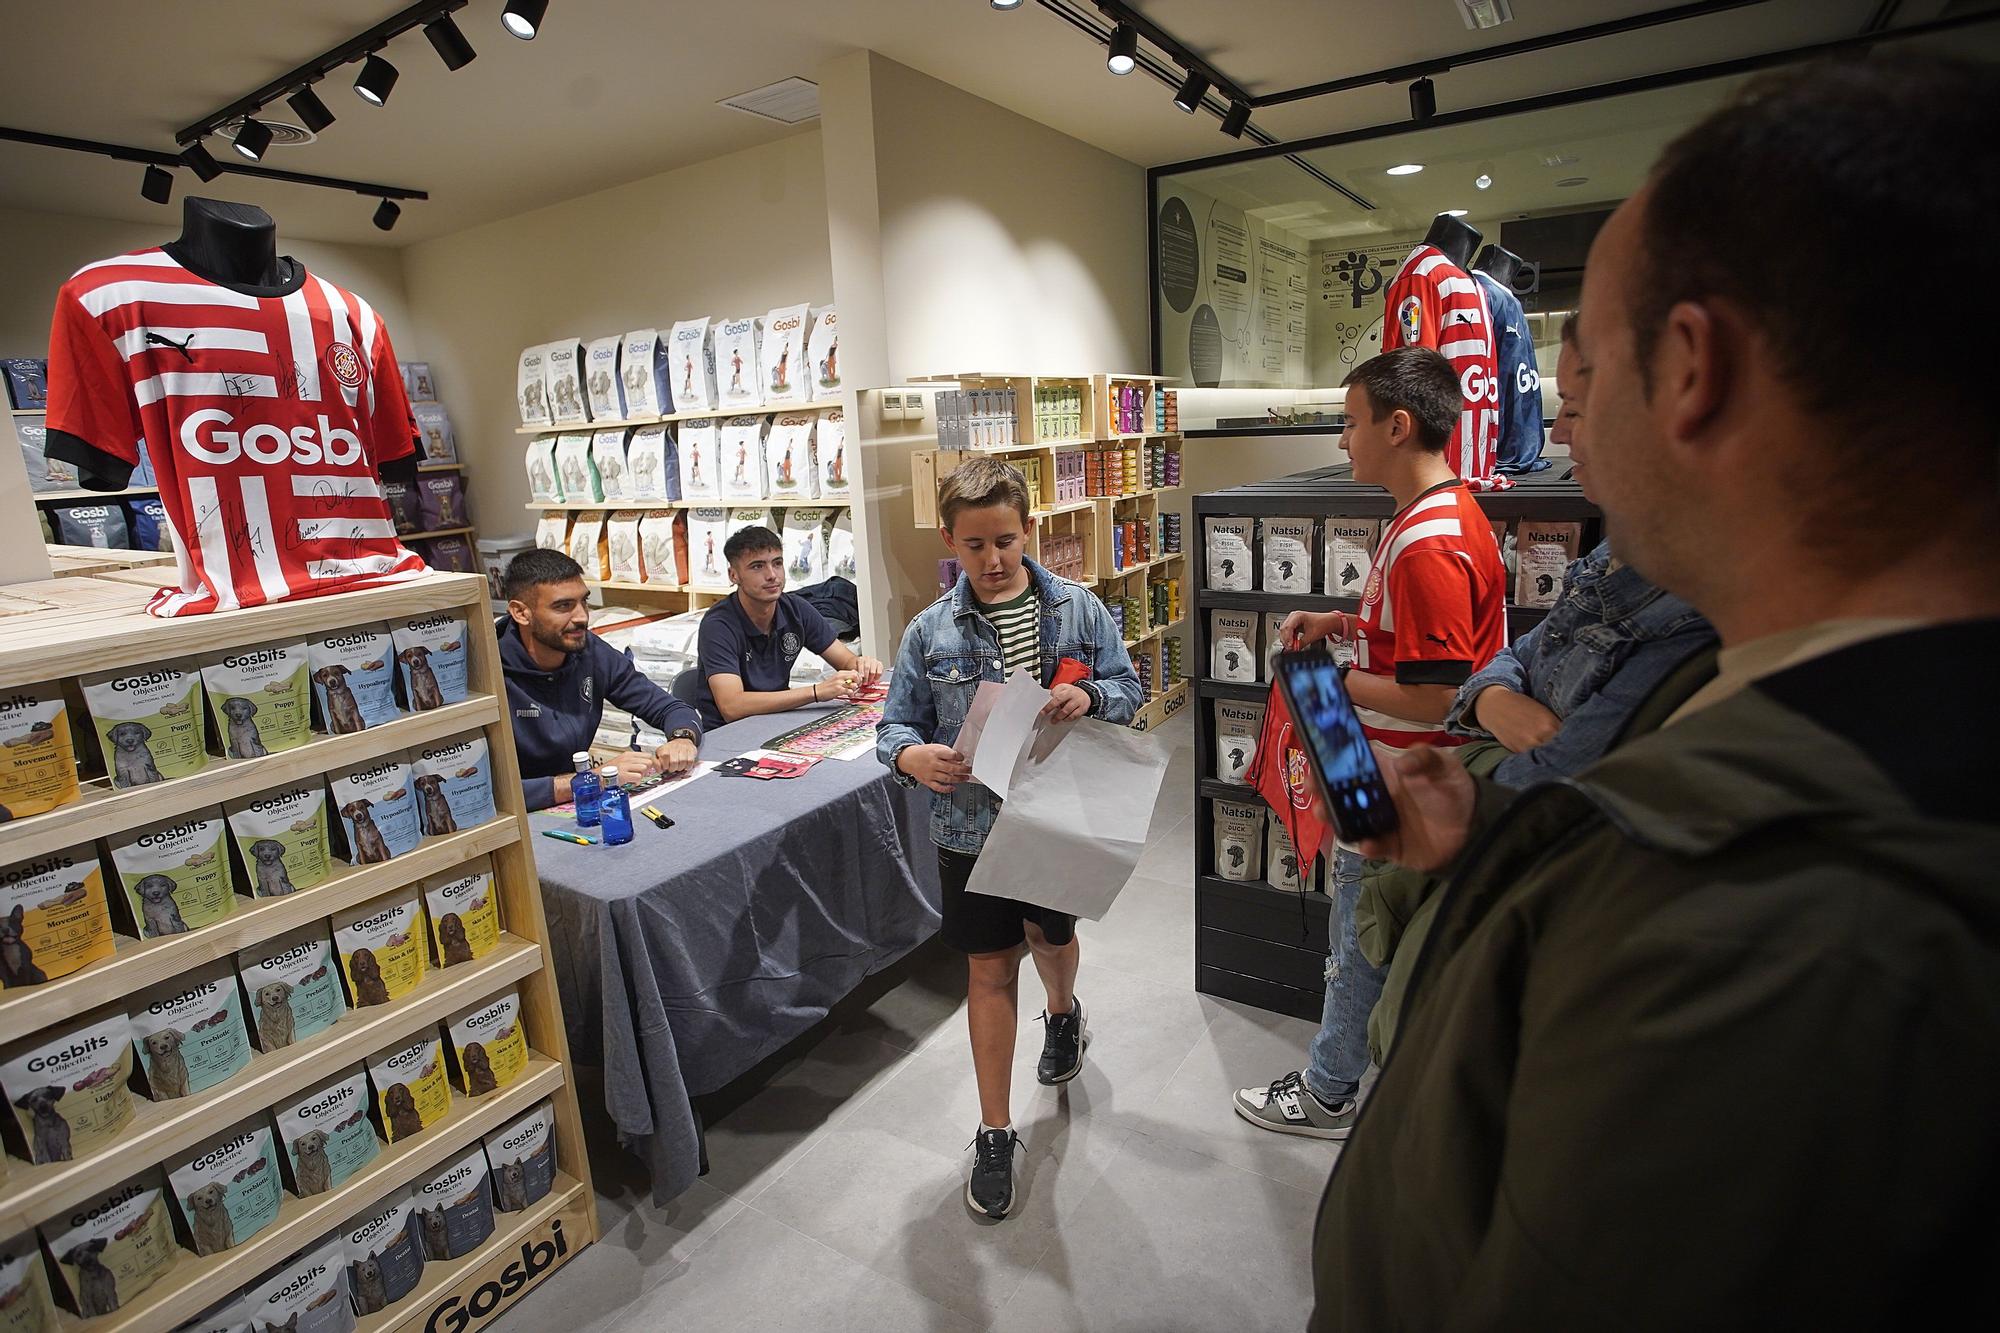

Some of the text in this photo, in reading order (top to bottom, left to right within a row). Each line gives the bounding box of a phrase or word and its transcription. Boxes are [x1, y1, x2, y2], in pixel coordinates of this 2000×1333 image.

[774, 316, 800, 331] Gosbi
[70, 507, 109, 518] Gosbi
[1214, 526, 1244, 534] Natsbi
[1271, 527, 1304, 536] Natsbi
[1334, 528, 1369, 537] Natsbi
[1528, 532, 1569, 542] Natsbi
[408, 614, 454, 632] Gosbits
[1218, 618, 1249, 628] Natsbi
[324, 631, 377, 649] Gosbits
[222, 648, 287, 670] Gosbits
[111, 668, 182, 692] Gosbits
[274, 700, 295, 710] Puppy
[1164, 691, 1186, 716] Gosbi
[1222, 708, 1258, 721] Natsbi
[171, 722, 192, 733] Puppy
[14, 752, 58, 768] Movement
[422, 742, 472, 760] Gosbits
[350, 762, 400, 784] Gosbits
[250, 786, 310, 814] Gosbits
[1222, 806, 1256, 819] Natsbi
[137, 819, 208, 848] Gosbits
[300, 836, 319, 848] Puppy
[12, 874, 56, 890] Objective
[195, 871, 217, 883] Puppy
[442, 873, 482, 898] Gosbits
[47, 910, 90, 928] Movement
[352, 906, 404, 932] Gosbits
[260, 939, 318, 970] Gosbits
[148, 982, 217, 1015] Gosbits
[466, 1002, 511, 1028] Gosbits
[201, 1029, 231, 1047] Prebiotic
[28, 1036, 109, 1072] Gosbits
[298, 1086, 354, 1118] Gosbits
[1288, 1104, 1299, 1115] DC
[502, 1119, 544, 1150] Gosbits
[192, 1133, 255, 1172] Gosbits
[422, 1165, 472, 1195] Gosbits
[70, 1183, 144, 1228] Gosbits
[462, 1207, 480, 1220] Dental
[351, 1205, 398, 1244] Gosbits
[268, 1264, 326, 1304] Gosbits
[422, 1218, 571, 1333] Gosbi
